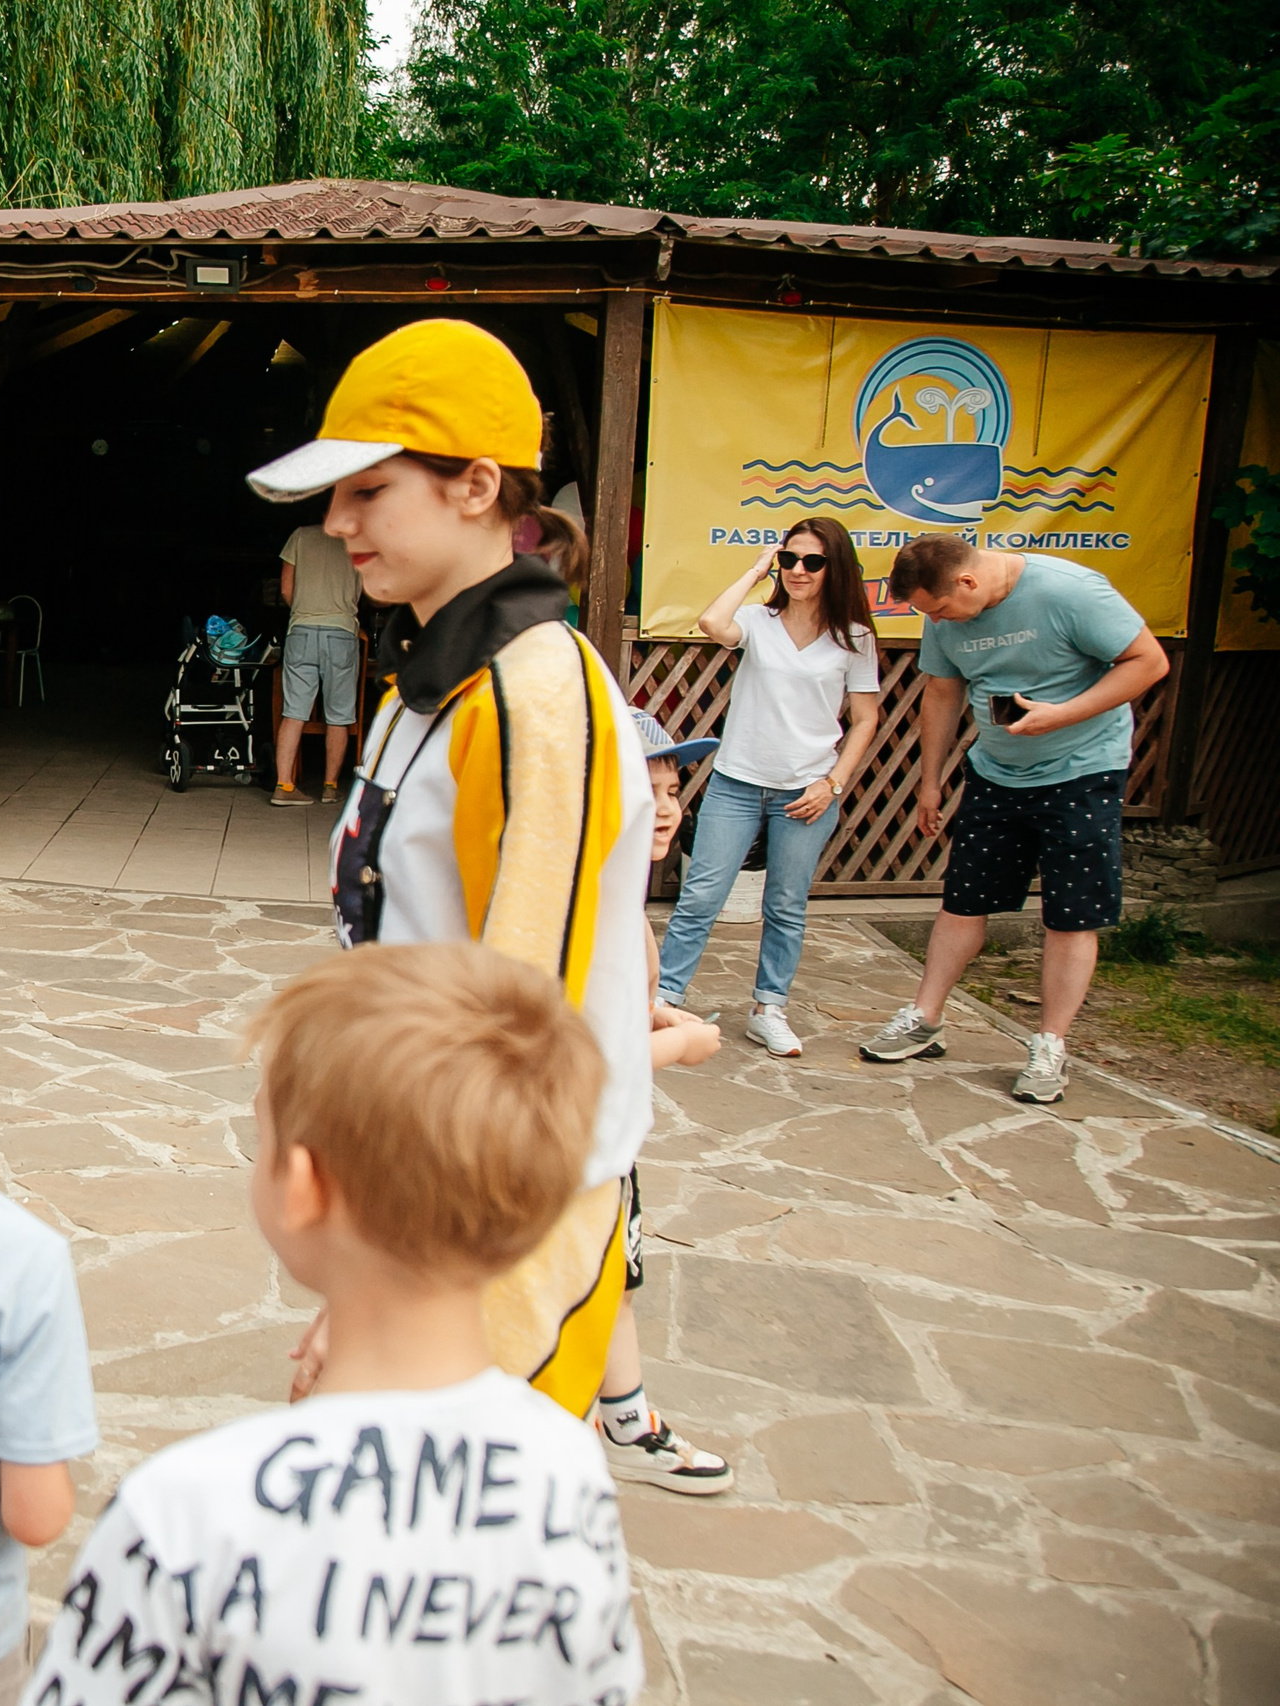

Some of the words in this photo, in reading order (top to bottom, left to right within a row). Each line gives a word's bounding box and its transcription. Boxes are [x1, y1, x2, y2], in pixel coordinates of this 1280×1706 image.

[986, 532, 1131, 549] КОМПЛЕКС
[254, 1424, 519, 1536] GAME
[315, 1560, 338, 1639] I
[361, 1574, 580, 1666] NEVER
